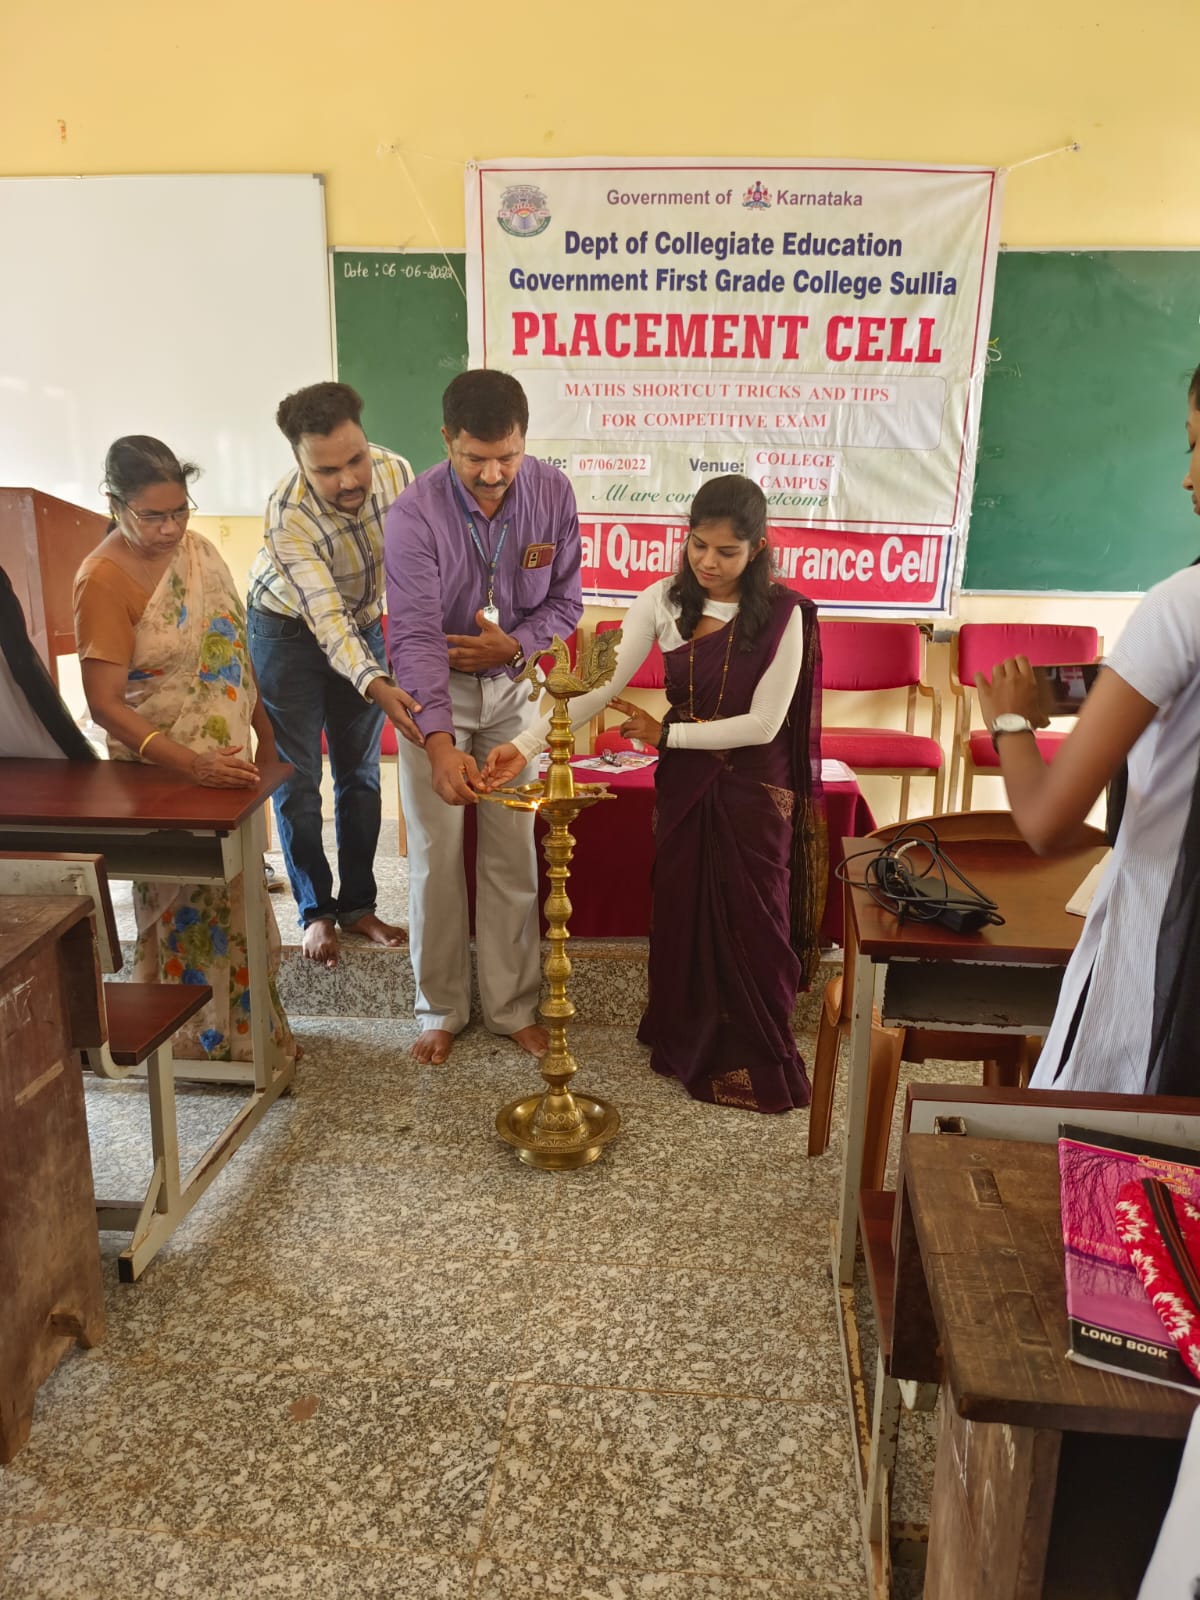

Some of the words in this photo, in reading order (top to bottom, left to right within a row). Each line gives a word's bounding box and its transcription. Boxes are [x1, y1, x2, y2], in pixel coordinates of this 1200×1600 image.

[606, 189, 710, 205] Government
[715, 189, 733, 205] of
[776, 189, 863, 206] Karnataka
[564, 231, 618, 260] Dept
[625, 231, 648, 255] of
[655, 231, 774, 261] Collegiate
[782, 232, 902, 257] Education
[344, 261, 369, 278] Date
[509, 268, 648, 292] Government
[655, 268, 708, 292] First
[715, 269, 785, 293] Grade
[793, 269, 882, 300] College
[890, 271, 957, 296] Sullia
[511, 311, 809, 360] PLACEMENT
[825, 315, 942, 363] CELL
[564, 383, 626, 398] MATHS
[735, 384, 801, 399] TRICKS
[808, 387, 846, 401] AND
[850, 387, 889, 402] TIPS
[601, 413, 637, 427] FOR
[643, 412, 767, 428] COMPETITIVE
[775, 414, 826, 428] EXAM
[579, 458, 647, 471] 07/06/2022
[689, 458, 744, 473] Venue:
[756, 452, 835, 467] COLLEGE
[759, 475, 829, 491] CAMPUS
[630, 492, 660, 503] are
[767, 492, 829, 507] elcome
[880, 536, 938, 583] Cell
[1080, 1326, 1123, 1346] LONG
[1126, 1340, 1168, 1359] BOOK
